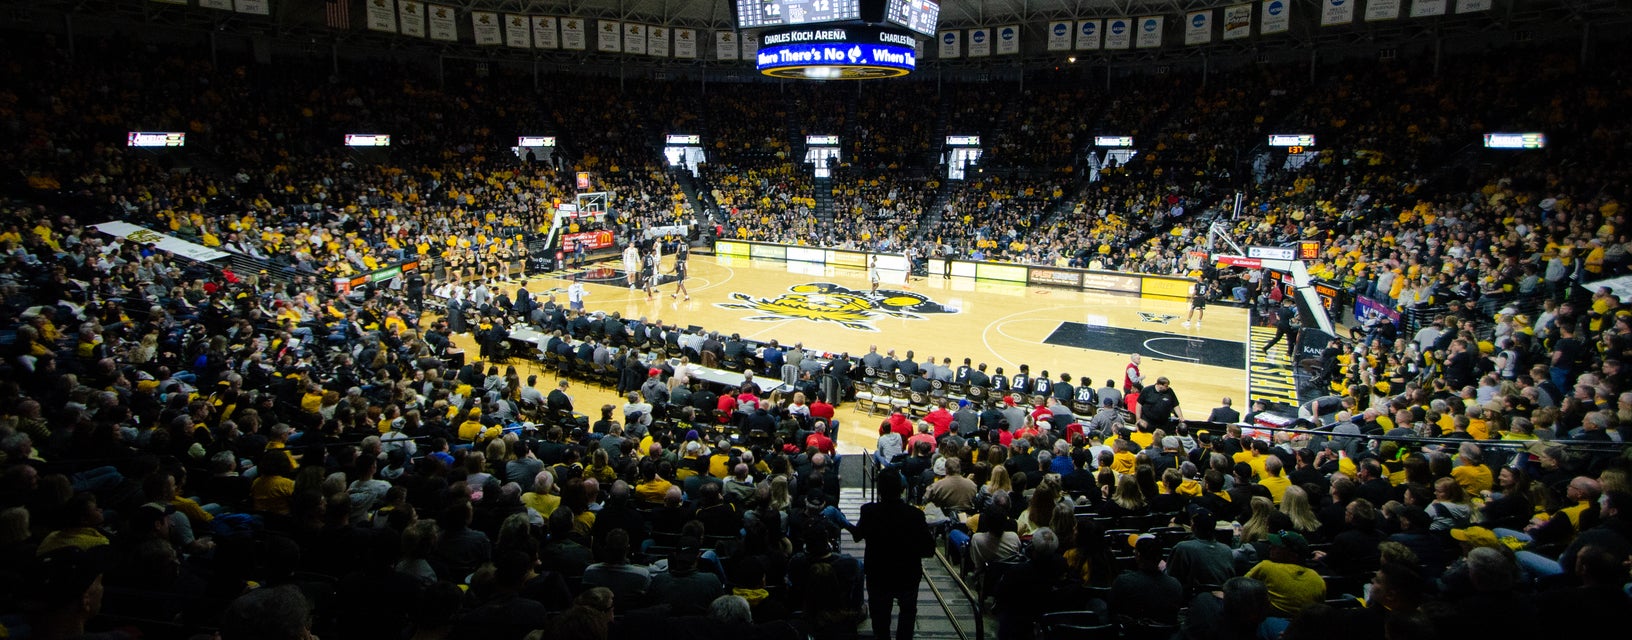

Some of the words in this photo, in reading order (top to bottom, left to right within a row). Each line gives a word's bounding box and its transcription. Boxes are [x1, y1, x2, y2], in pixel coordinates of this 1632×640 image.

[764, 4, 780, 15] 12
[812, 0, 829, 11] 12
[902, 4, 910, 16] 12
[765, 33, 790, 45] CHARLES
[791, 31, 813, 42] KOCH
[815, 30, 846, 40] ARENA
[880, 32, 906, 45] CHARLES
[780, 48, 821, 62] There's
[824, 48, 844, 60] No
[873, 48, 904, 64] Where
[995, 380, 1001, 389] 3
[1037, 382, 1047, 392] 10
[1250, 365, 1300, 408] STATE
[1078, 391, 1090, 401] 20
